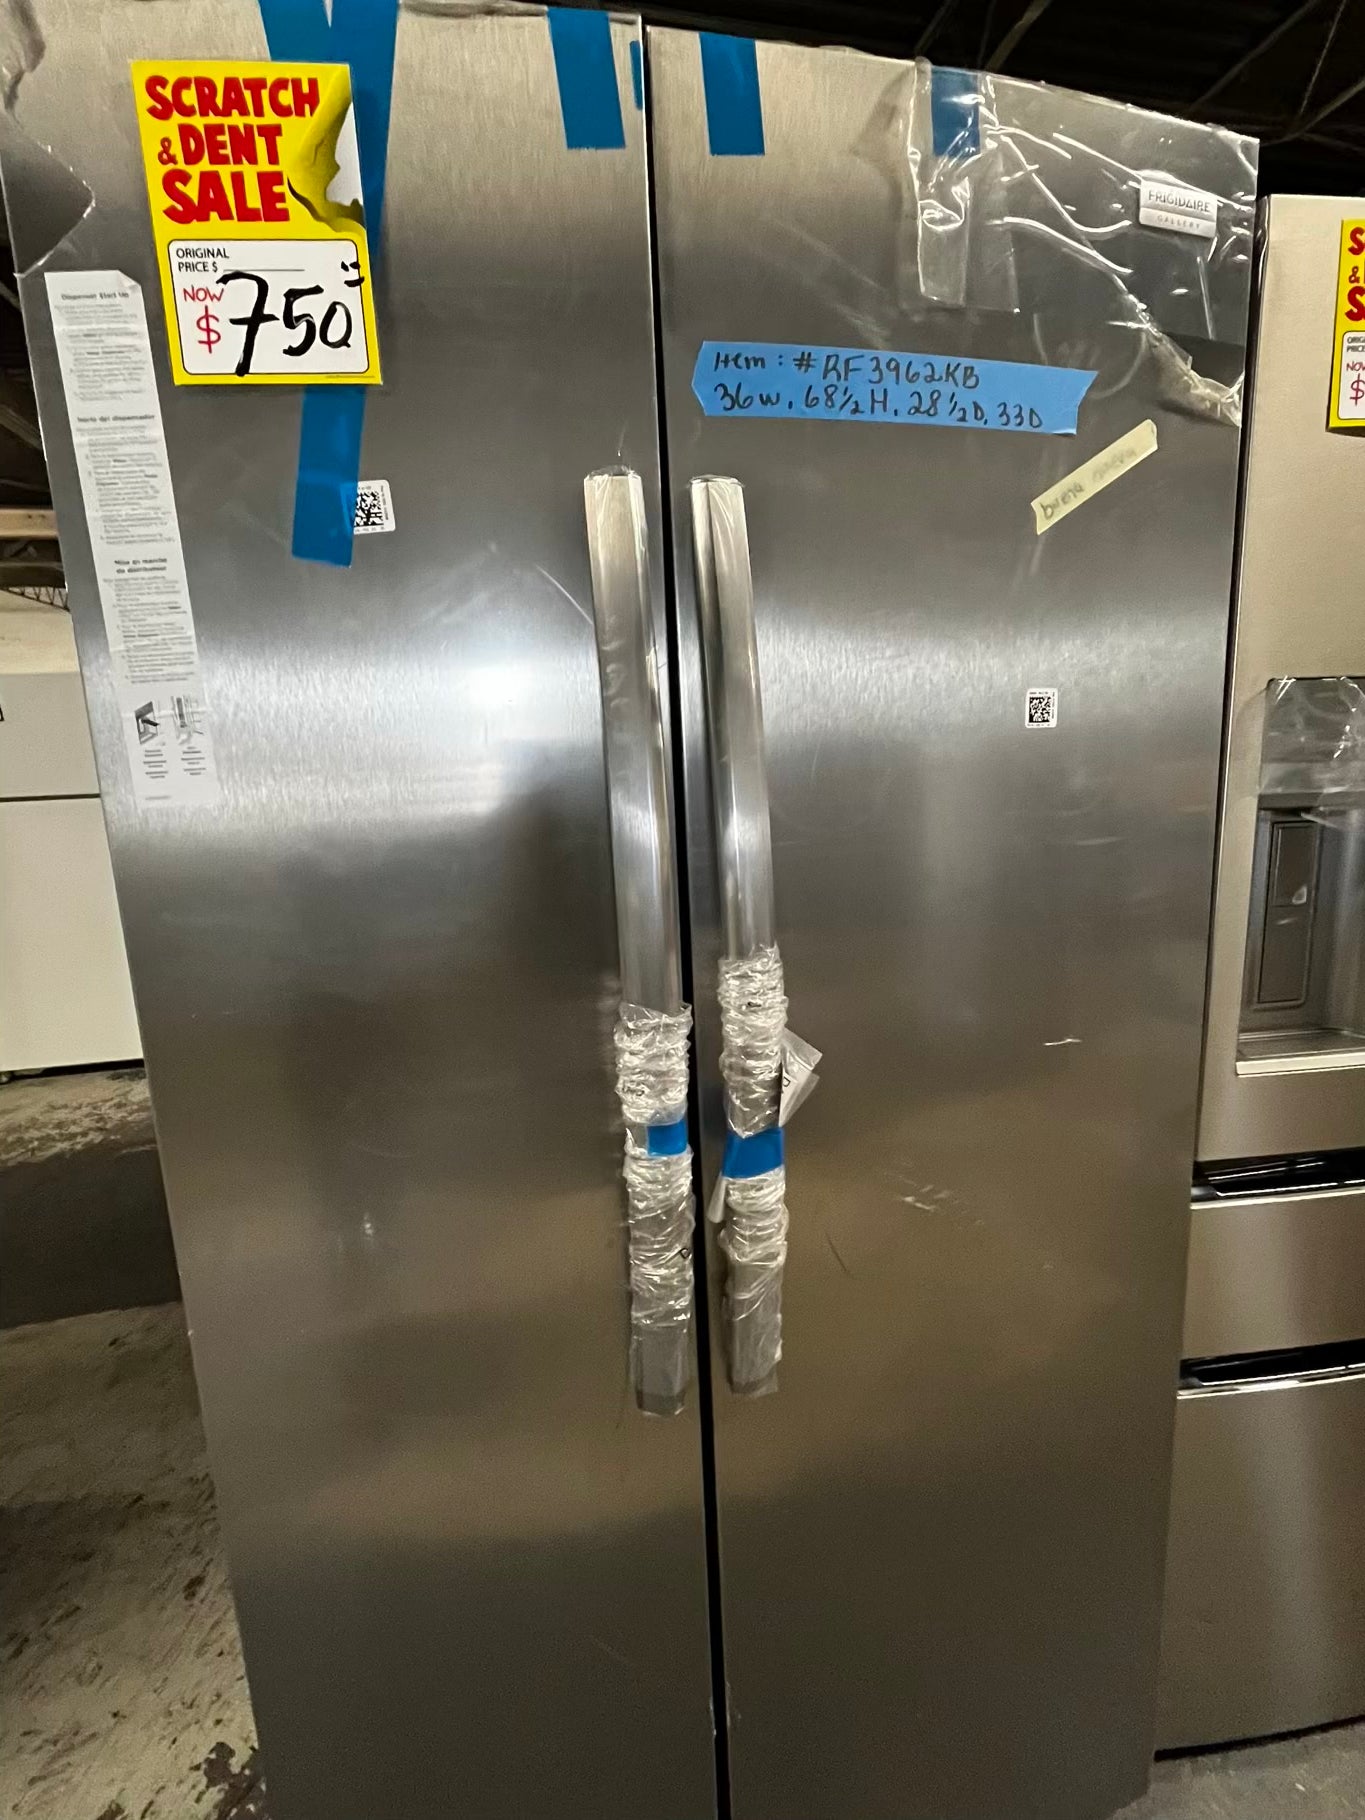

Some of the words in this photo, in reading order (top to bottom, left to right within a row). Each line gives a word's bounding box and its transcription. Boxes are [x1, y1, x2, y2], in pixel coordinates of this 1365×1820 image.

[145, 75, 320, 121] SCRATCH
[157, 137, 178, 165] &
[178, 123, 283, 166] DENT
[162, 169, 290, 224] SALE
[1149, 190, 1211, 213] FRIGIDAIRE
[1157, 214, 1200, 229] GALLERY
[176, 247, 230, 259] ORIGINAL
[178, 261, 209, 273] PRICE
[211, 260, 218, 273] $
[183, 284, 225, 302] NOW
[196, 305, 222, 354] $
[215, 270, 352, 377] 750
